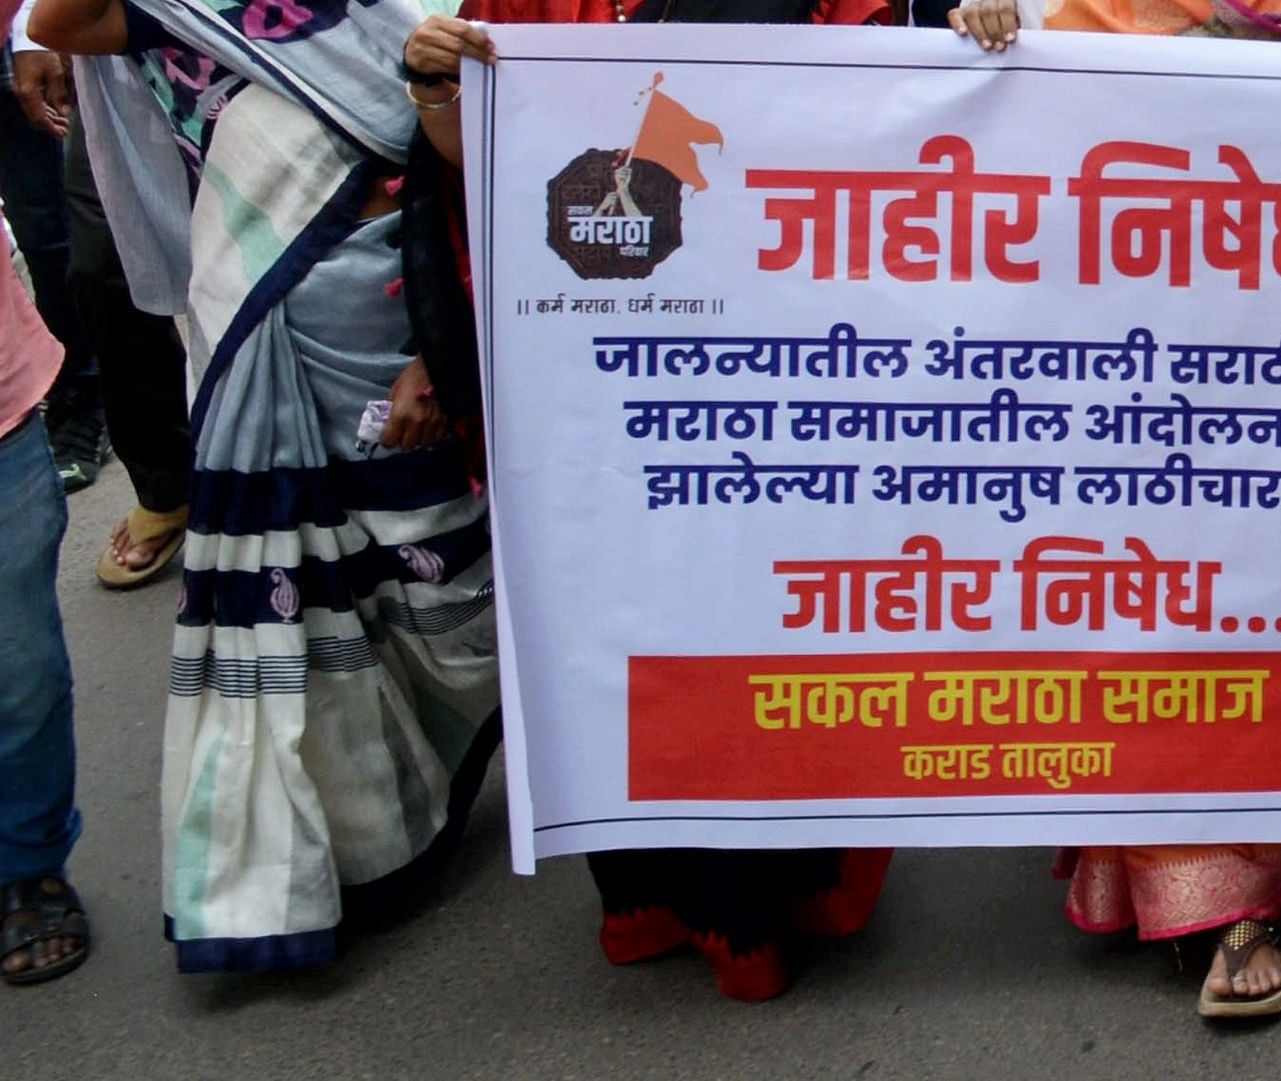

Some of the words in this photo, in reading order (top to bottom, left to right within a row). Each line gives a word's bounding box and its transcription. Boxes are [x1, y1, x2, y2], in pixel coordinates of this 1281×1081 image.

[567, 216, 654, 244] मराठा
[745, 134, 1051, 281] जाहीर
[536, 293, 565, 315] कर्म
[627, 293, 655, 315] धर्म
[659, 297, 704, 315] मराठा
[593, 323, 911, 378] जालन्यातील
[924, 326, 1159, 383] अंतरवाली
[623, 401, 778, 441] मराठा
[787, 387, 1073, 443] समाजातील
[643, 451, 860, 510] झालेल्या
[871, 464, 1065, 523] अमानुष
[773, 534, 1001, 634] जाहीर
[748, 671, 914, 730] सकल
[922, 670, 1086, 726] मराठा
[1097, 668, 1270, 723] समाज
[901, 744, 992, 780] कराड
[999, 741, 1115, 789] तालुका
